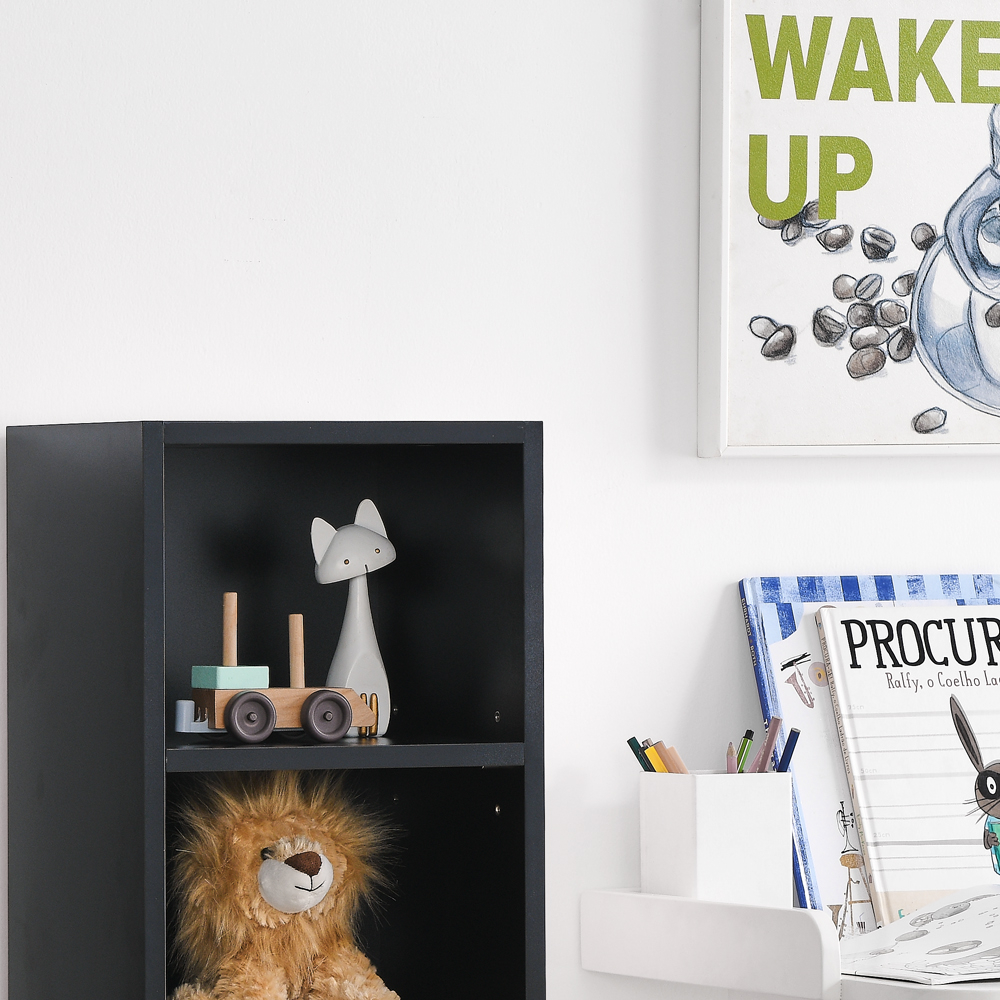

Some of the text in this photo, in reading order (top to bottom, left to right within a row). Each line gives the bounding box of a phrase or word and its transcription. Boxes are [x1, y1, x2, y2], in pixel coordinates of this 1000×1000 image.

[745, 14, 1000, 104] WAKE
[748, 134, 873, 220] UP
[841, 618, 1000, 669] PROCUR
[885, 672, 923, 693] Ralfy,
[928, 679, 935, 688] o
[938, 671, 981, 687] Coelho
